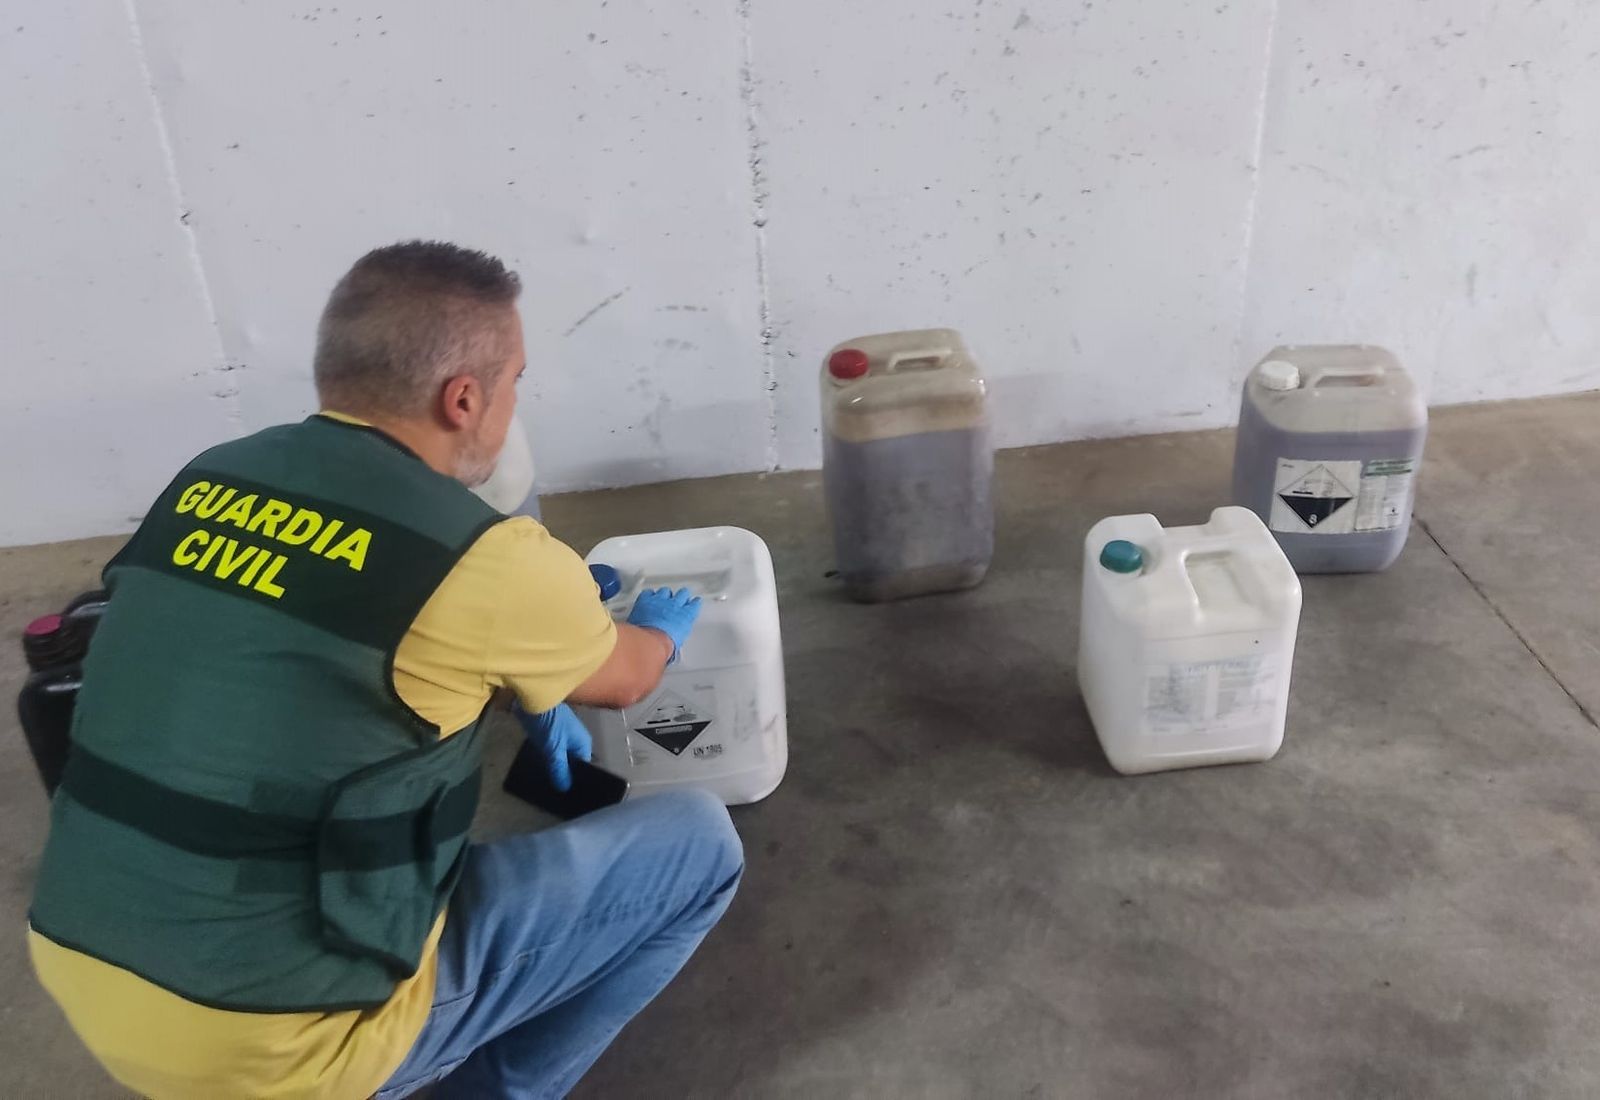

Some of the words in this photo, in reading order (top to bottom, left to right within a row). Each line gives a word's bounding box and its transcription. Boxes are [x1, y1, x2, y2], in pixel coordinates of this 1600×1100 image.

[175, 481, 372, 571] GUARDIA
[1309, 514, 1318, 524] 8
[172, 529, 288, 599] CIVIL
